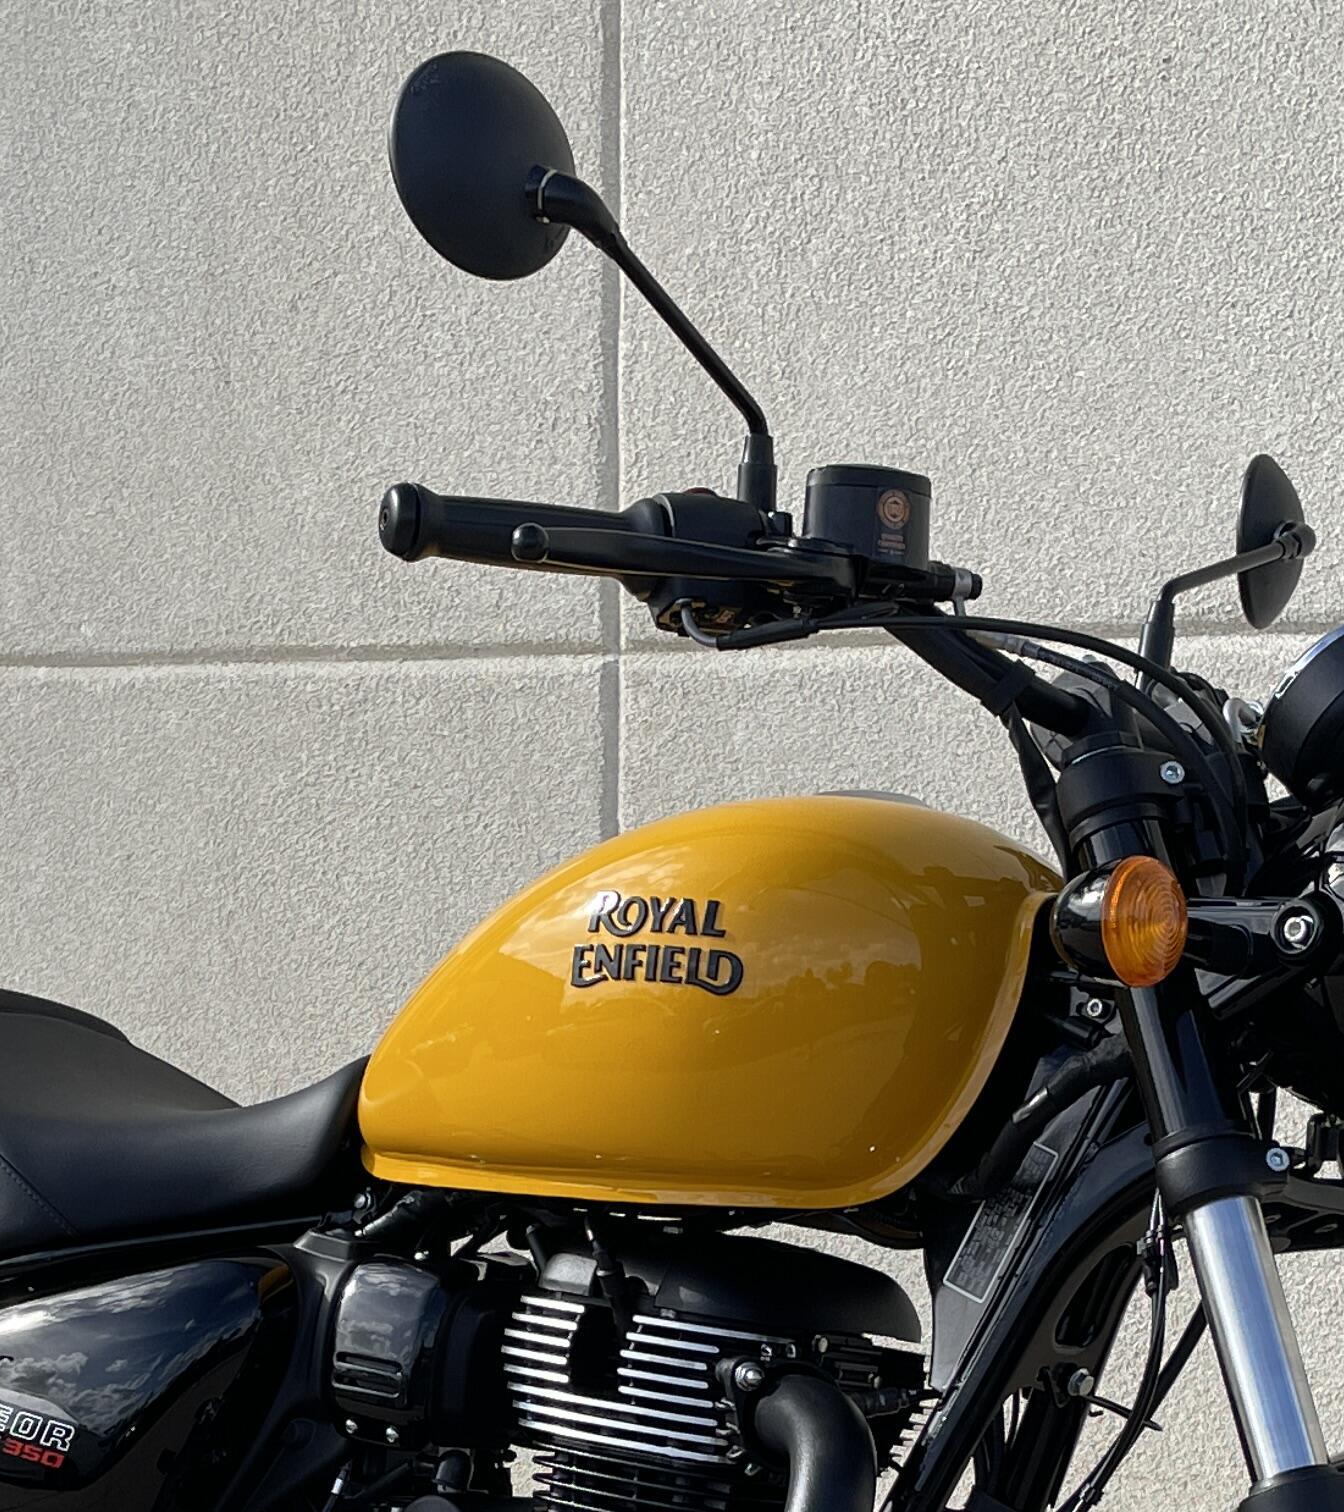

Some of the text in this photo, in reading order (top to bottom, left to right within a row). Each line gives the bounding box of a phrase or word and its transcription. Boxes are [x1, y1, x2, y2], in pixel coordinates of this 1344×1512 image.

[587, 890, 726, 937] ROYAL
[571, 943, 744, 996] ENFIELD
[2, 1437, 65, 1468] 350
